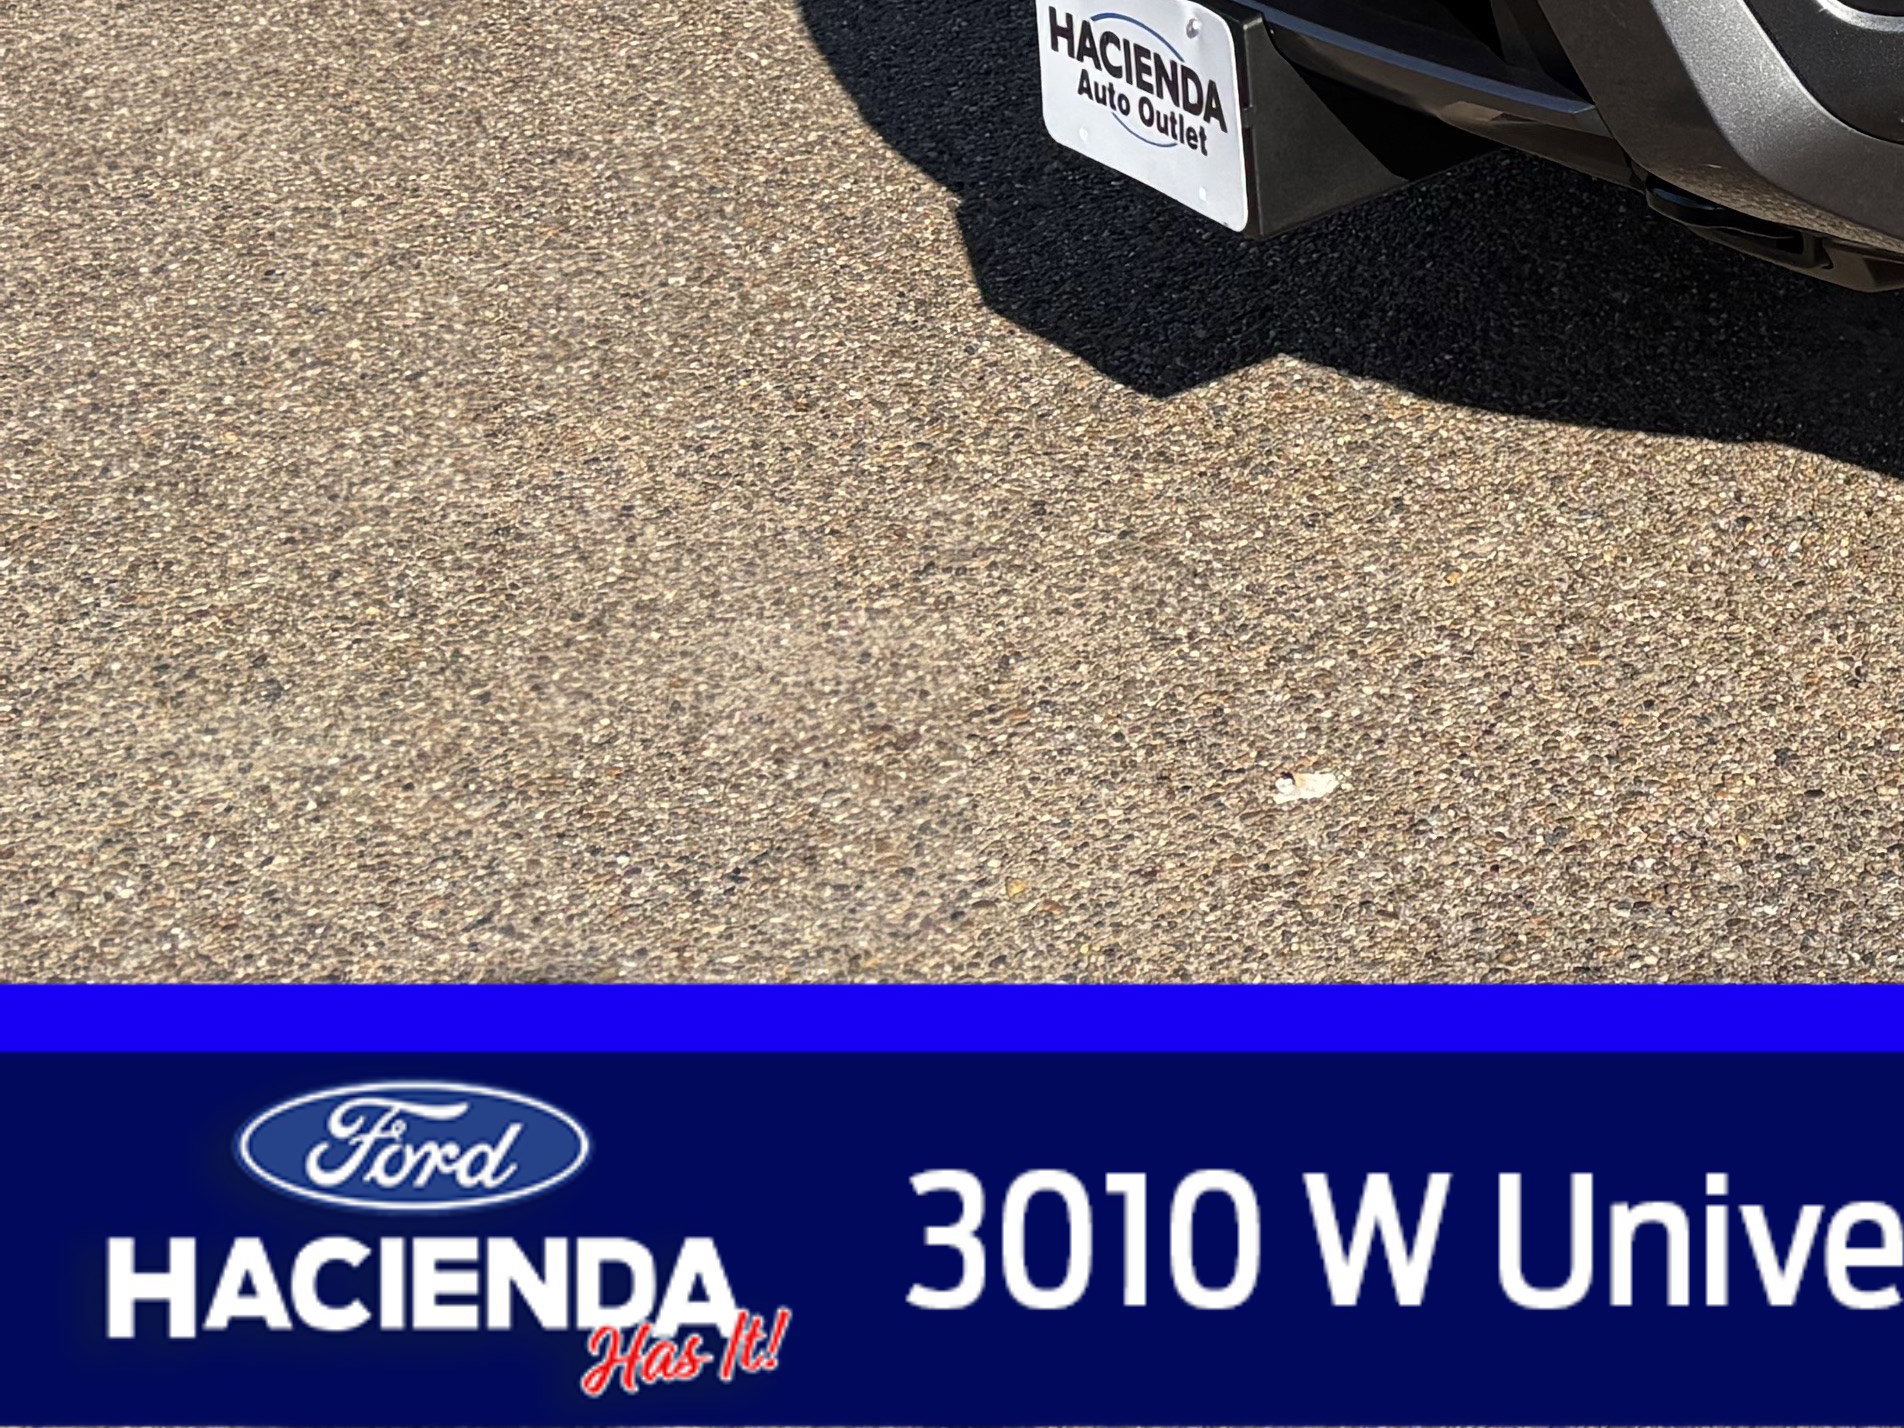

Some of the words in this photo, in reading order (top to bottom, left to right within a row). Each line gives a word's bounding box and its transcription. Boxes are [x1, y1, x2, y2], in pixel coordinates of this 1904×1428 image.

[1048, 5, 1229, 134] HACIENDA
[1077, 68, 1131, 117] Auto
[1138, 95, 1208, 158] Outlet
